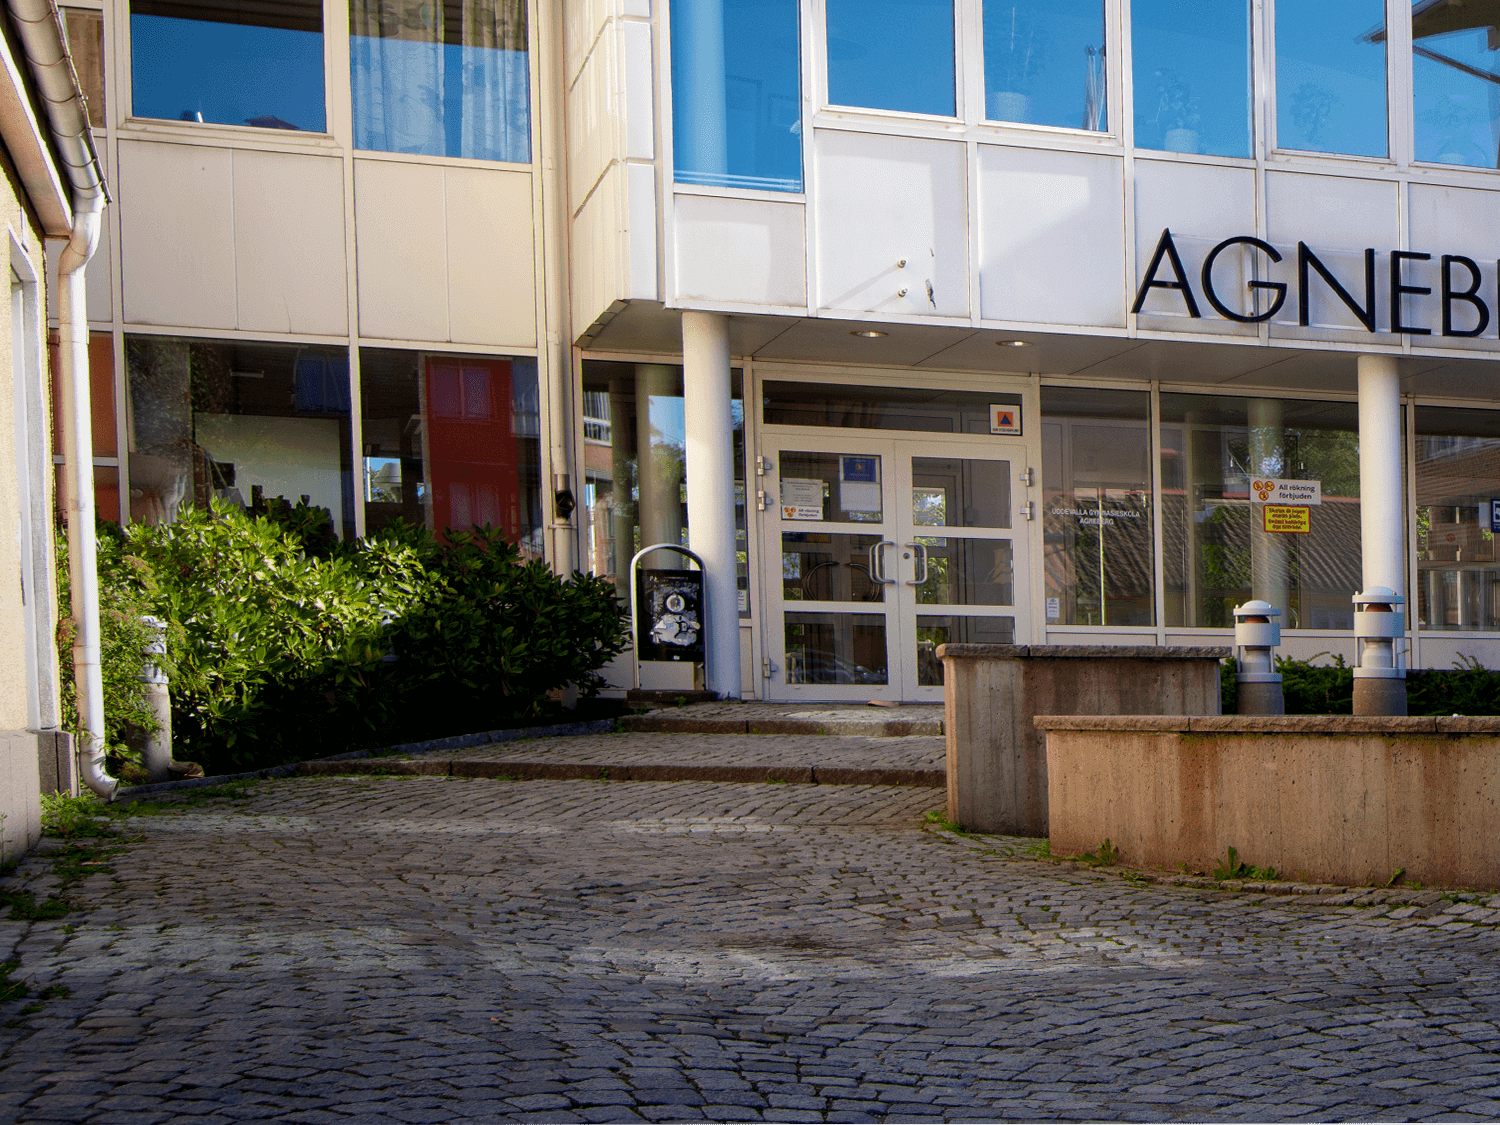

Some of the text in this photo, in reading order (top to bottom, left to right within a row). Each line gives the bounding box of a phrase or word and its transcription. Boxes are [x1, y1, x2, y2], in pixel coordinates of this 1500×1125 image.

[1289, 484, 1315, 493] rökning
[1279, 492, 1312, 500] förbjuden
[1051, 508, 1088, 516] UDDEVALLA
